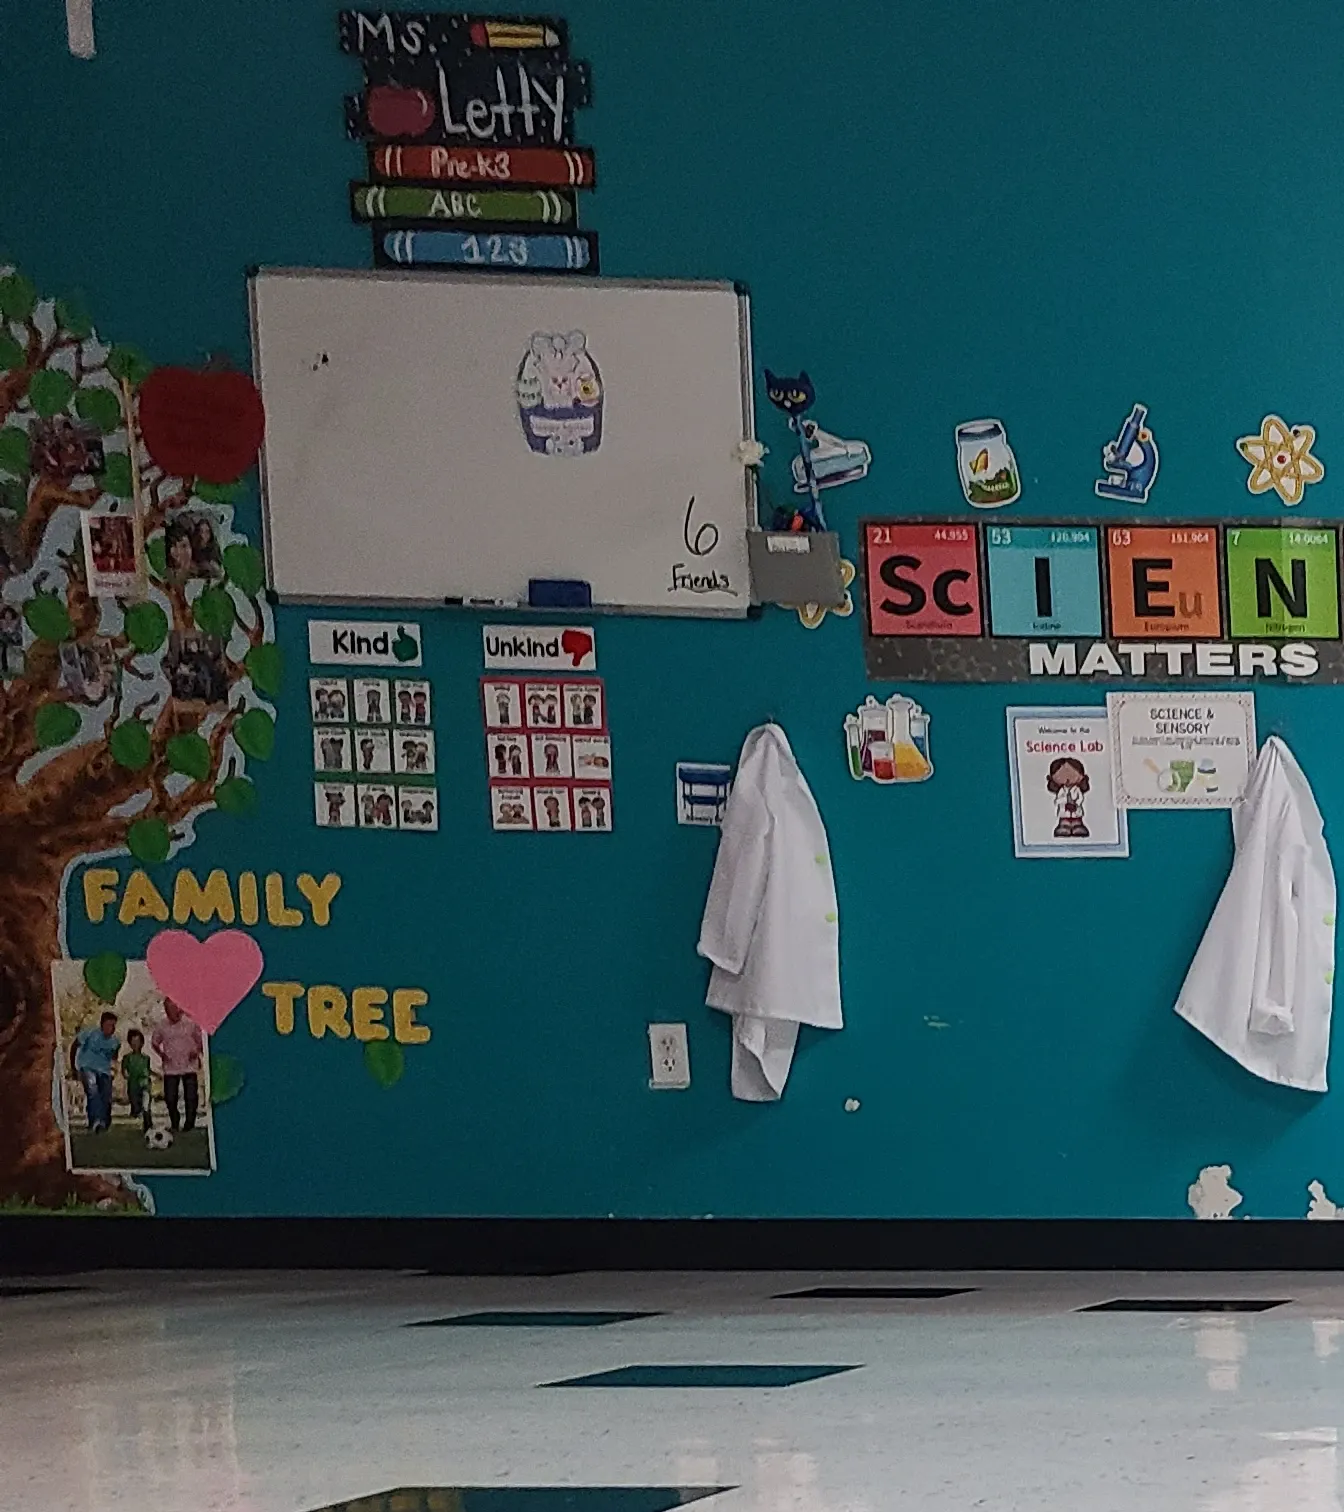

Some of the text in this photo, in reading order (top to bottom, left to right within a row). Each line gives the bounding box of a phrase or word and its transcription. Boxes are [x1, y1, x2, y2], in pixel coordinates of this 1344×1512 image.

[357, 13, 437, 53] Ms.
[436, 60, 564, 142] Letty
[428, 190, 482, 218] ABC
[462, 235, 528, 266] 123
[684, 495, 719, 556] 6
[873, 529, 892, 544] 21
[1231, 530, 1240, 546] 7
[672, 563, 730, 591] Friends
[332, 629, 389, 655] Kind
[486, 636, 559, 657] Unkind
[1029, 642, 1319, 677] MATTERS
[1150, 707, 1201, 720] SCIENCE
[1155, 722, 1210, 735] SENSORY
[1026, 740, 1103, 753] Science Lab
[83, 868, 341, 927] FAMILY
[262, 981, 431, 1044] TREE
